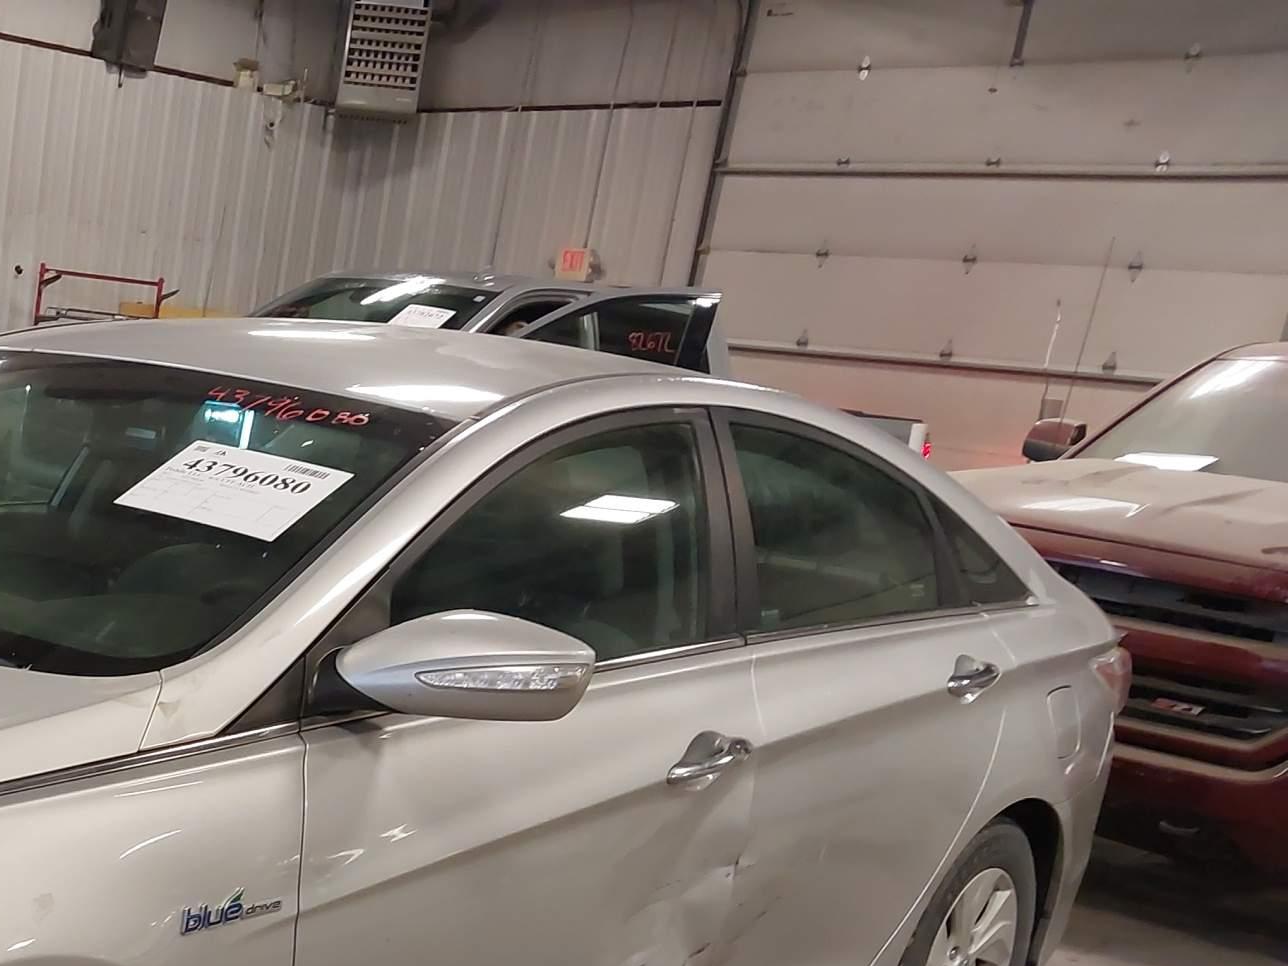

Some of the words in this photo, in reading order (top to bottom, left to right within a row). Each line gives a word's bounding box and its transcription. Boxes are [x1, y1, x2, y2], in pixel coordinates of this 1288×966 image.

[562, 250, 585, 272] EXIT
[207, 385, 371, 427] 43796080
[183, 458, 312, 494] 43796080
[181, 888, 245, 935] blue
[245, 900, 282, 916] drive
